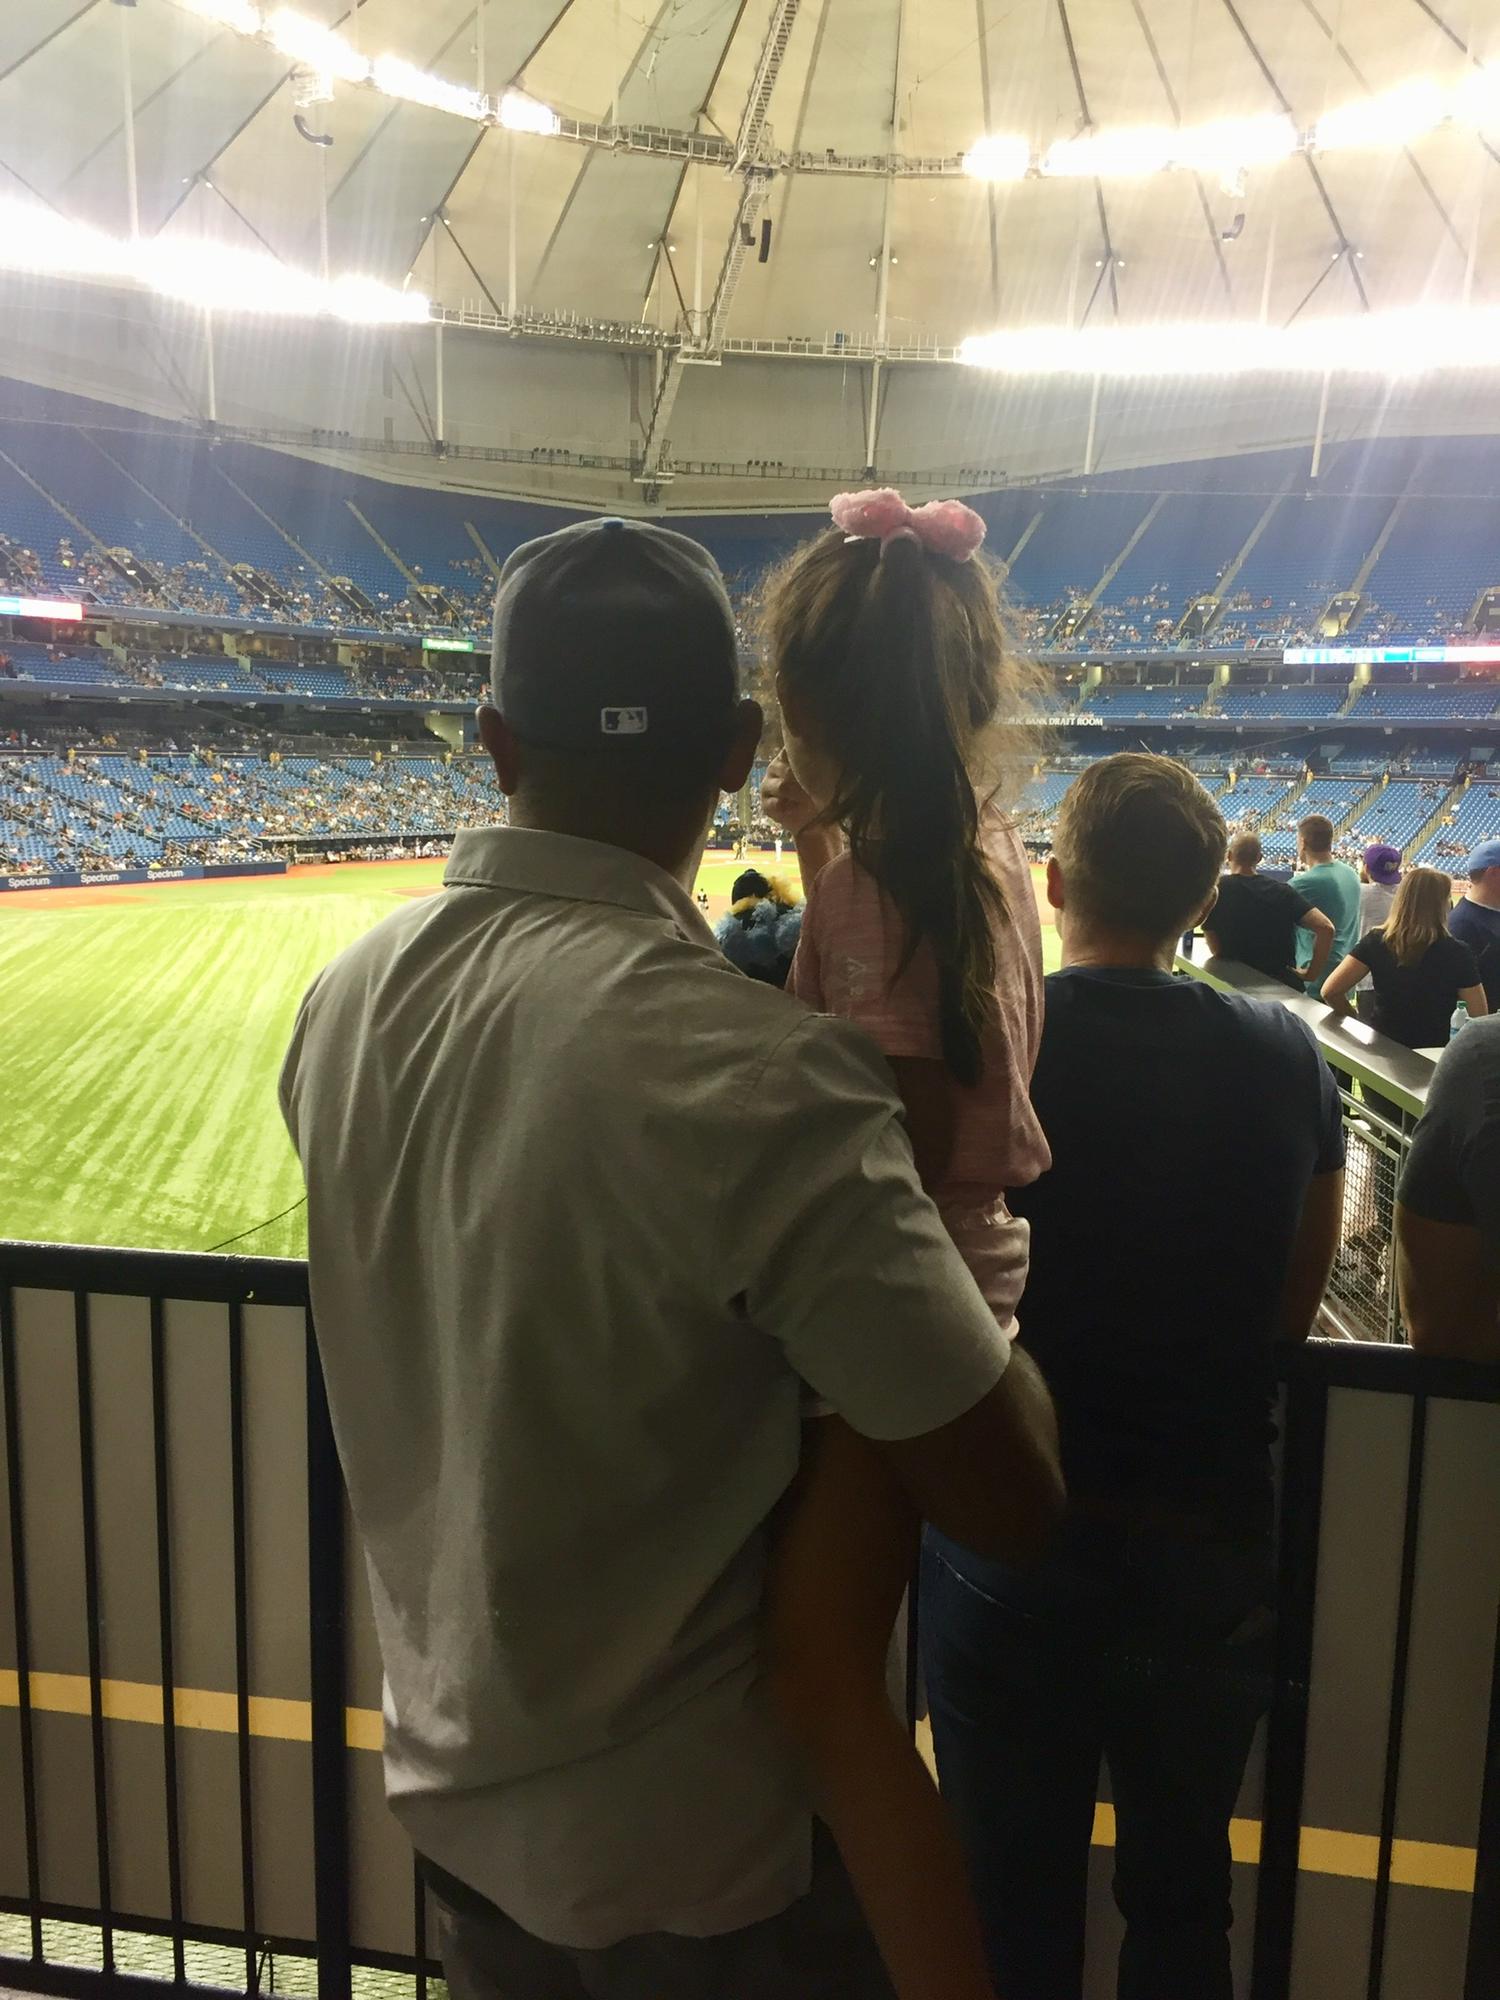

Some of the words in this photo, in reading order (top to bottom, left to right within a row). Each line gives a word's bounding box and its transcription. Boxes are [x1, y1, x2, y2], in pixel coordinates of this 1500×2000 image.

[1048, 717, 1076, 726] DRAFT
[1077, 717, 1103, 726] ROOM
[80, 873, 119, 884] Spectrum
[147, 870, 184, 880] Spectrum
[8, 877, 50, 888] Spectrum
